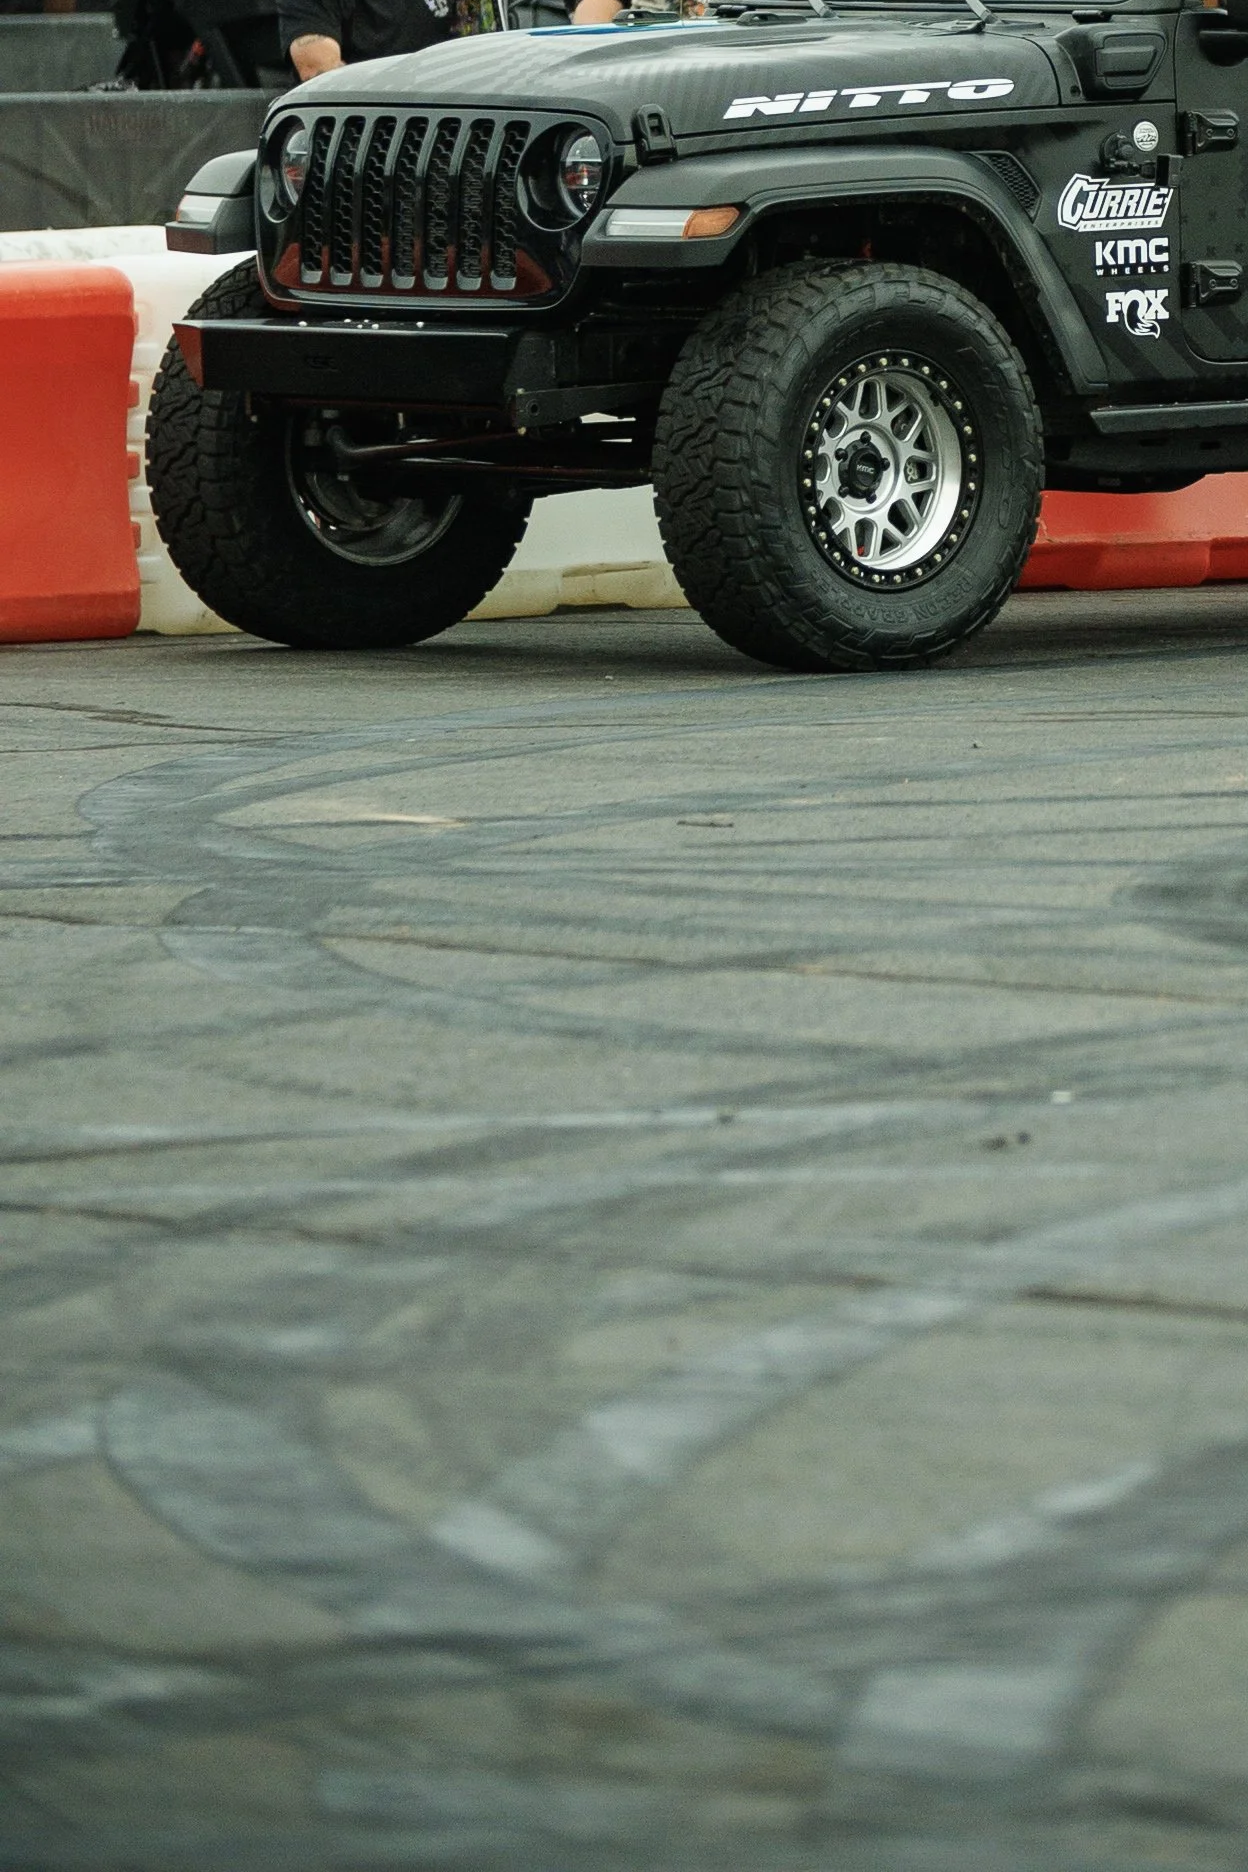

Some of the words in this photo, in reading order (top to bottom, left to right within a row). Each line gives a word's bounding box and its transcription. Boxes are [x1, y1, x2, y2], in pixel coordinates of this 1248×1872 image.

[723, 78, 1015, 120] NITTO
[1062, 178, 1170, 225] CURRIE
[1082, 219, 1160, 230] ENTERPRISES
[1094, 236, 1170, 267] KMC
[1095, 264, 1170, 277] WHEELS
[1105, 288, 1170, 339] FOX
